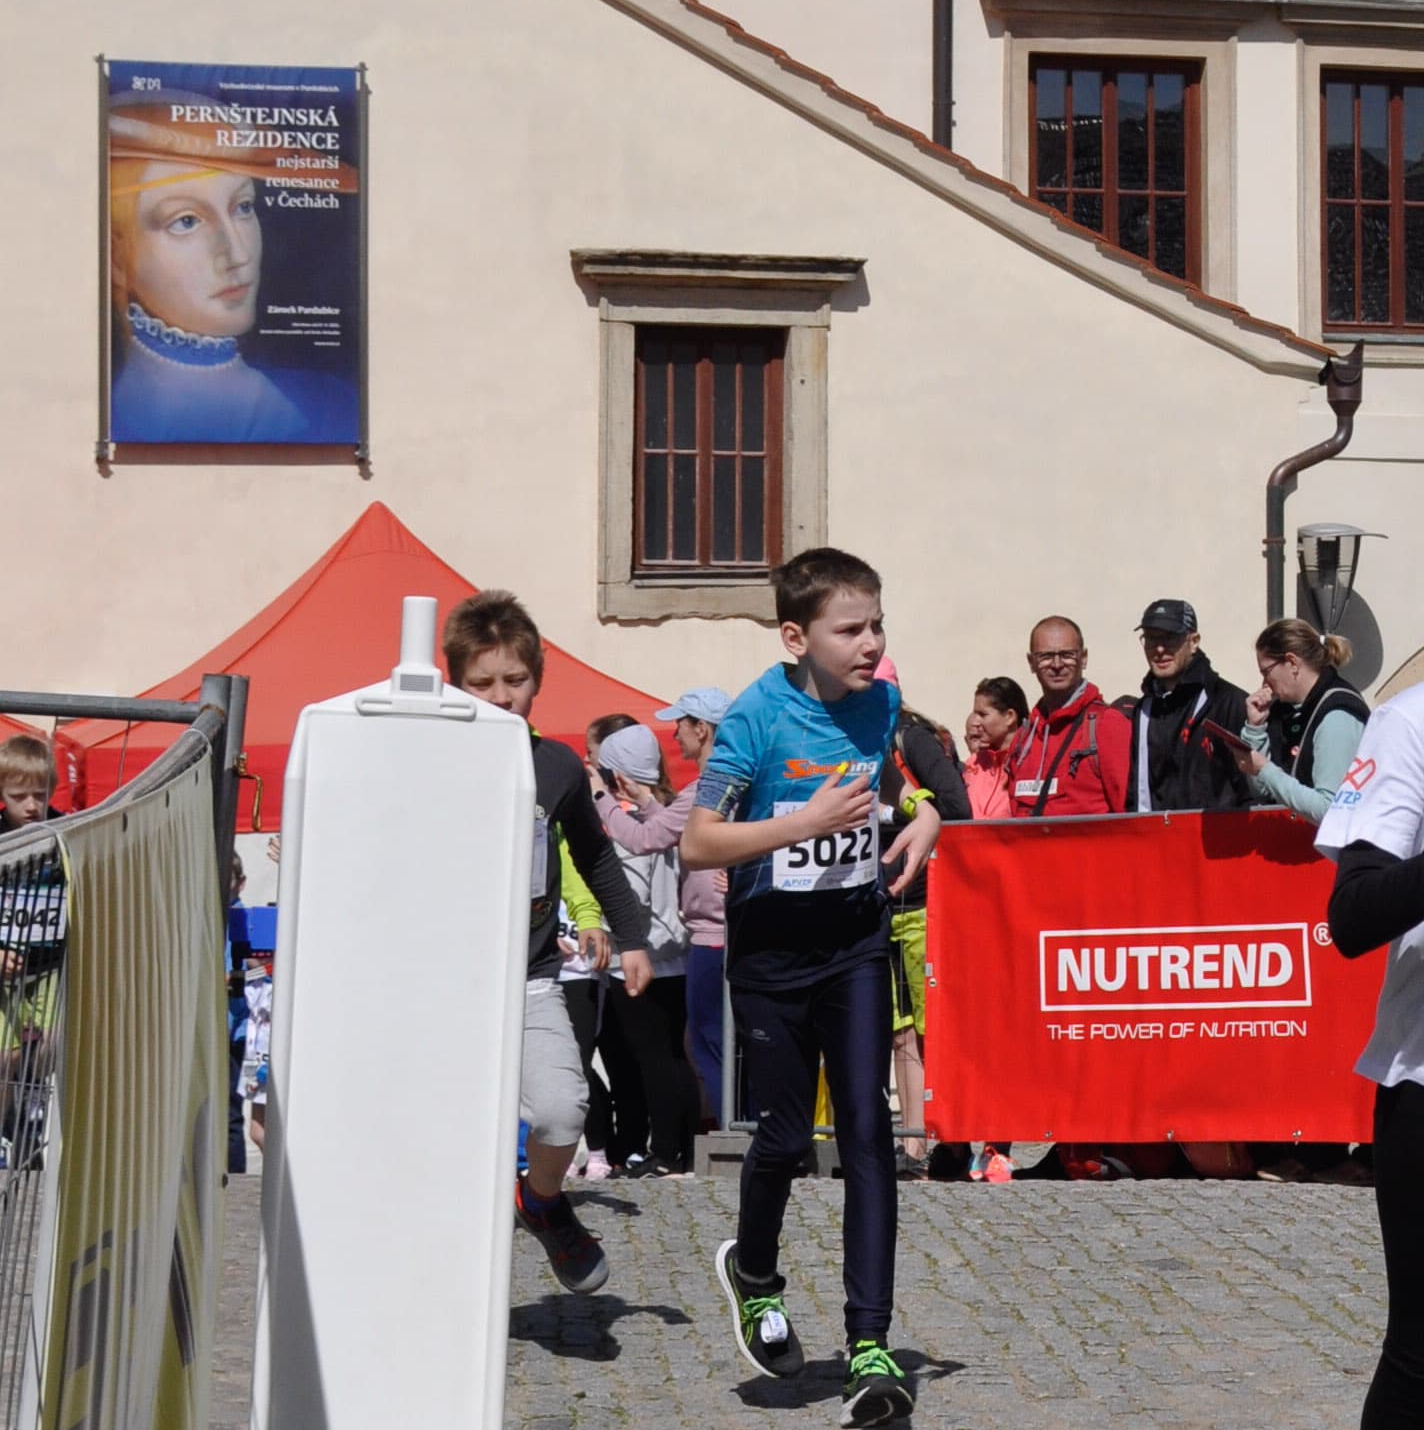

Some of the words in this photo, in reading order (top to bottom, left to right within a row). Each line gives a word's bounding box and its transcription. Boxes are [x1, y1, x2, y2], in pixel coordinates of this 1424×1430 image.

[171, 103, 339, 126] PERNŠTEJNSKÁ
[216, 129, 339, 150] REZIDENCE
[276, 155, 339, 170] nejstarší
[265, 176, 339, 189] renesance
[264, 195, 275, 207] v
[277, 191, 339, 208] Čechách
[787, 826, 873, 868] 5022
[1057, 942, 1294, 992] NUTREND
[1047, 1024, 1084, 1040] THE
[1090, 1023, 1163, 1039] POWER
[1169, 1021, 1195, 1038] OF
[1199, 1020, 1307, 1038] NUTRITION
